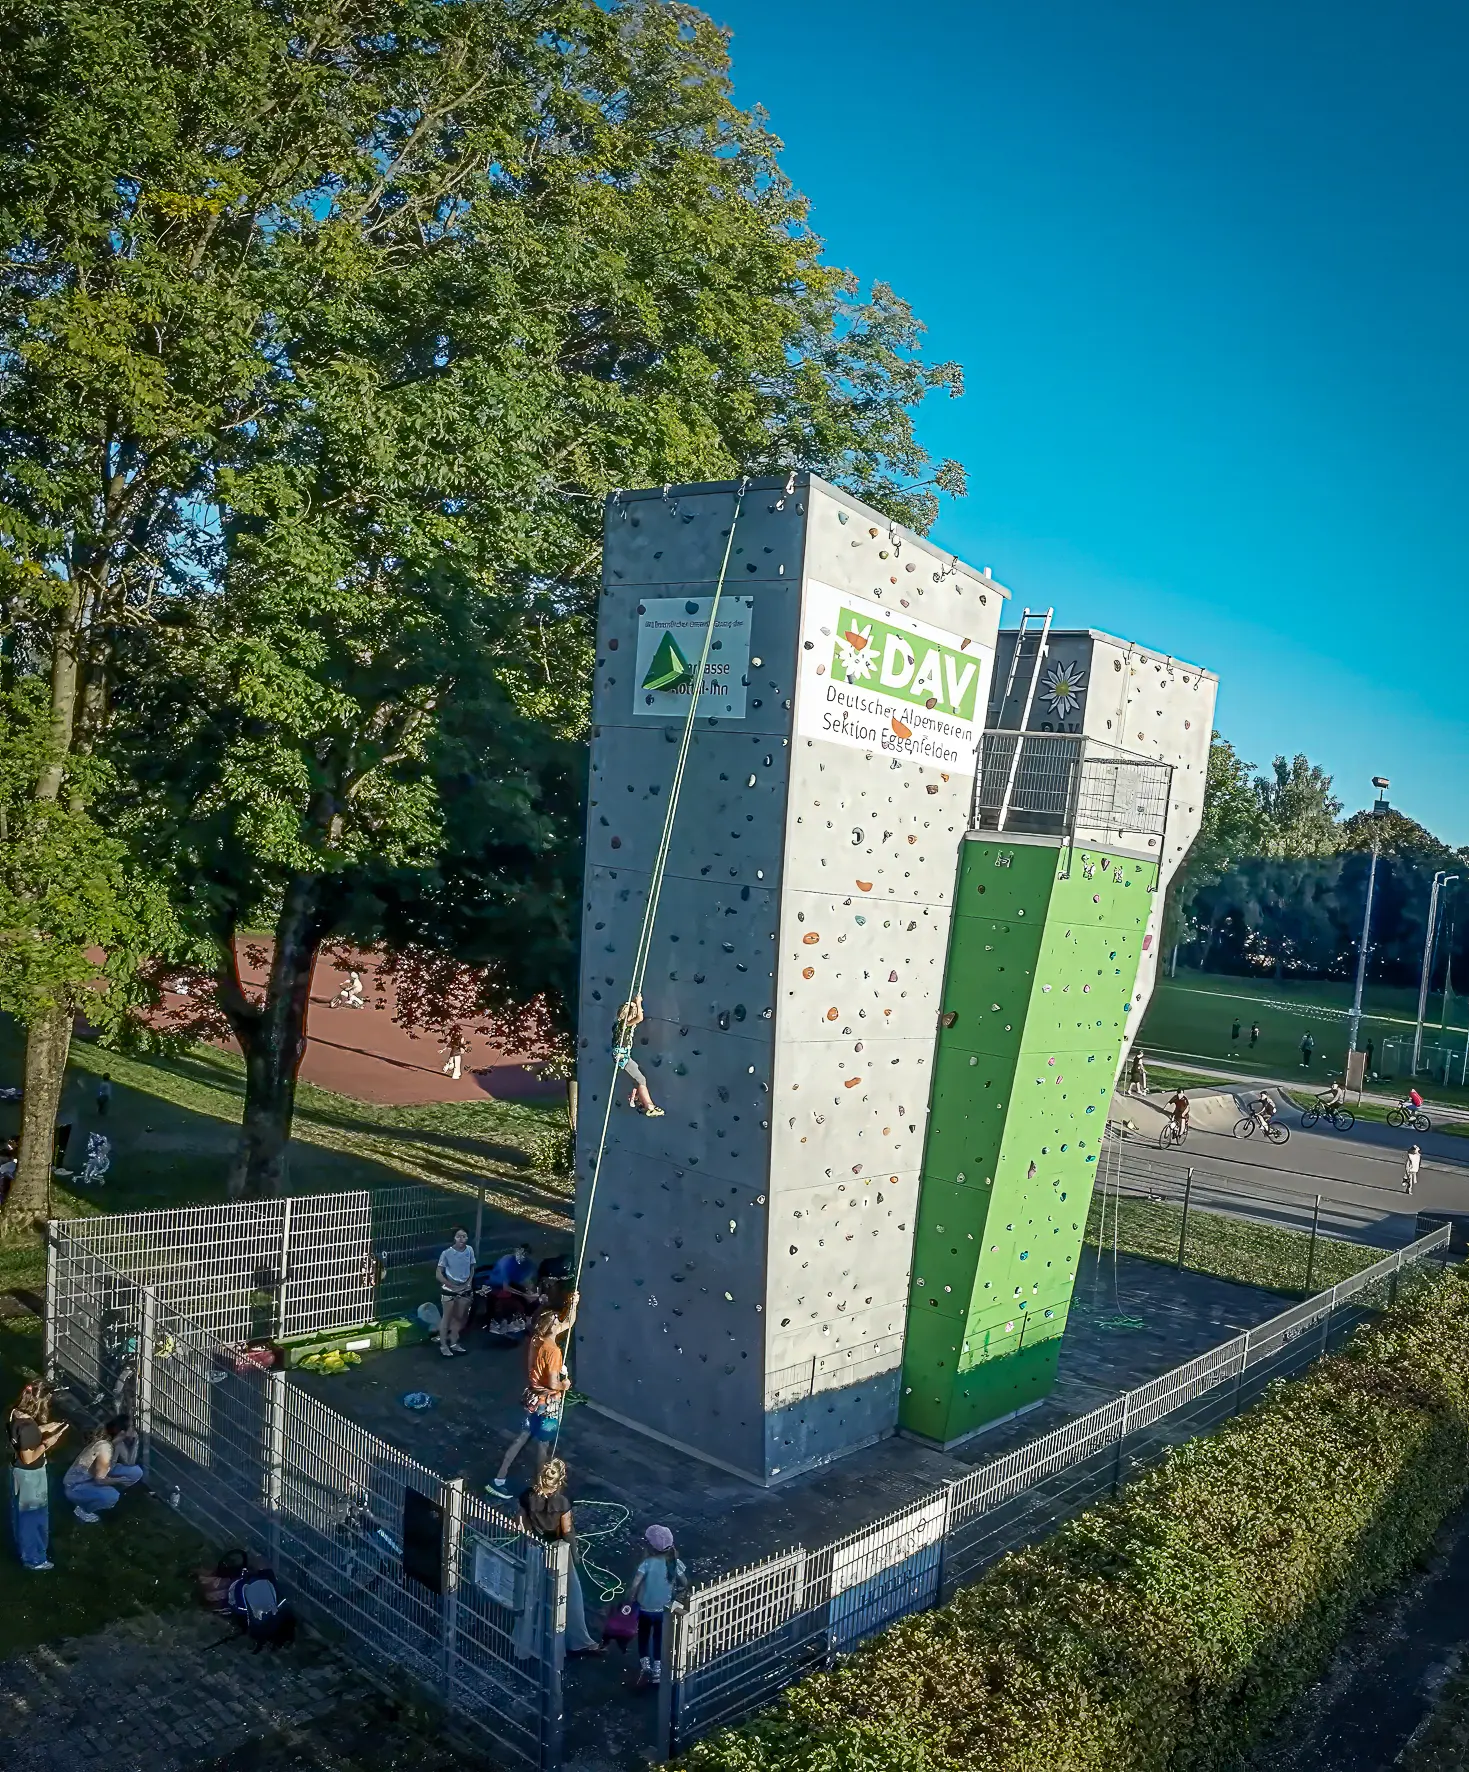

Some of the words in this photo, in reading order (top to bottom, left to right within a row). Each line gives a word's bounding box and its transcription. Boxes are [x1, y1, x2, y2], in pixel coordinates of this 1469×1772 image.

[880, 634, 976, 711] DAV
[823, 712, 876, 741] Sektion
[881, 728, 958, 763] Eggenfelden
[826, 685, 897, 719] Deutscher
[900, 708, 972, 742] Alpenverein
